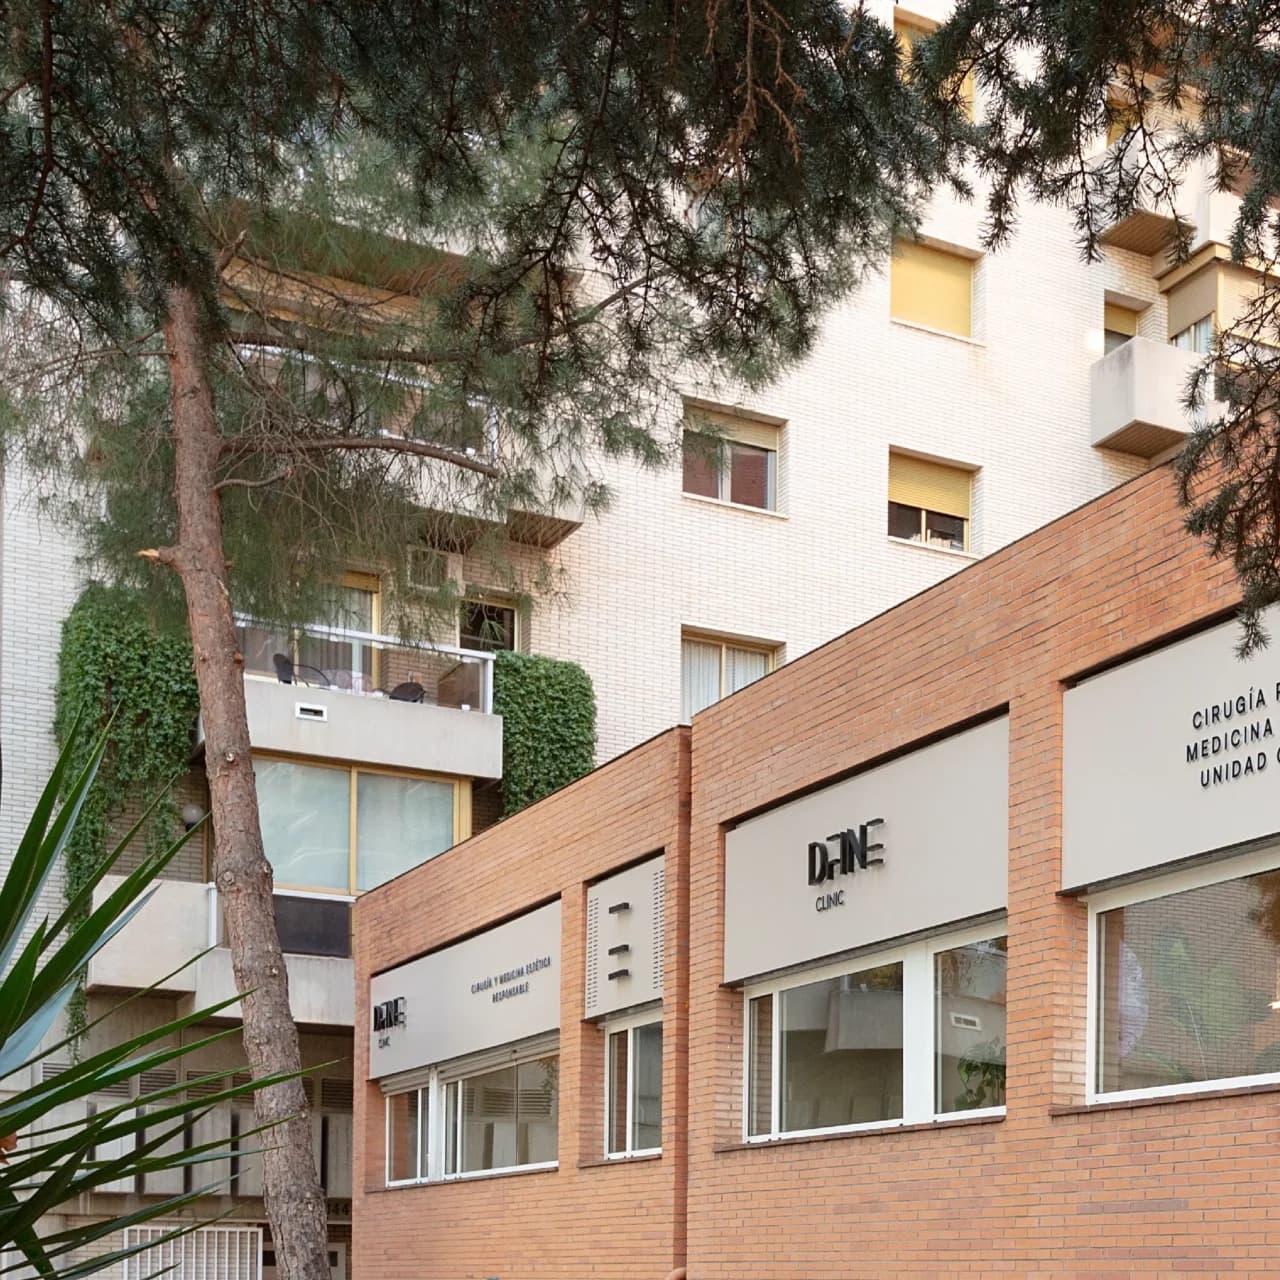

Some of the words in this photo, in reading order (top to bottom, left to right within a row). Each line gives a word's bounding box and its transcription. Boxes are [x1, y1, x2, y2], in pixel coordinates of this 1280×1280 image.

[1192, 686, 1266, 730] CIRUGÍA
[1186, 718, 1273, 762] MEDICINA
[1200, 752, 1267, 787] UNIDAD
[816, 890, 844, 912] CLINIC
